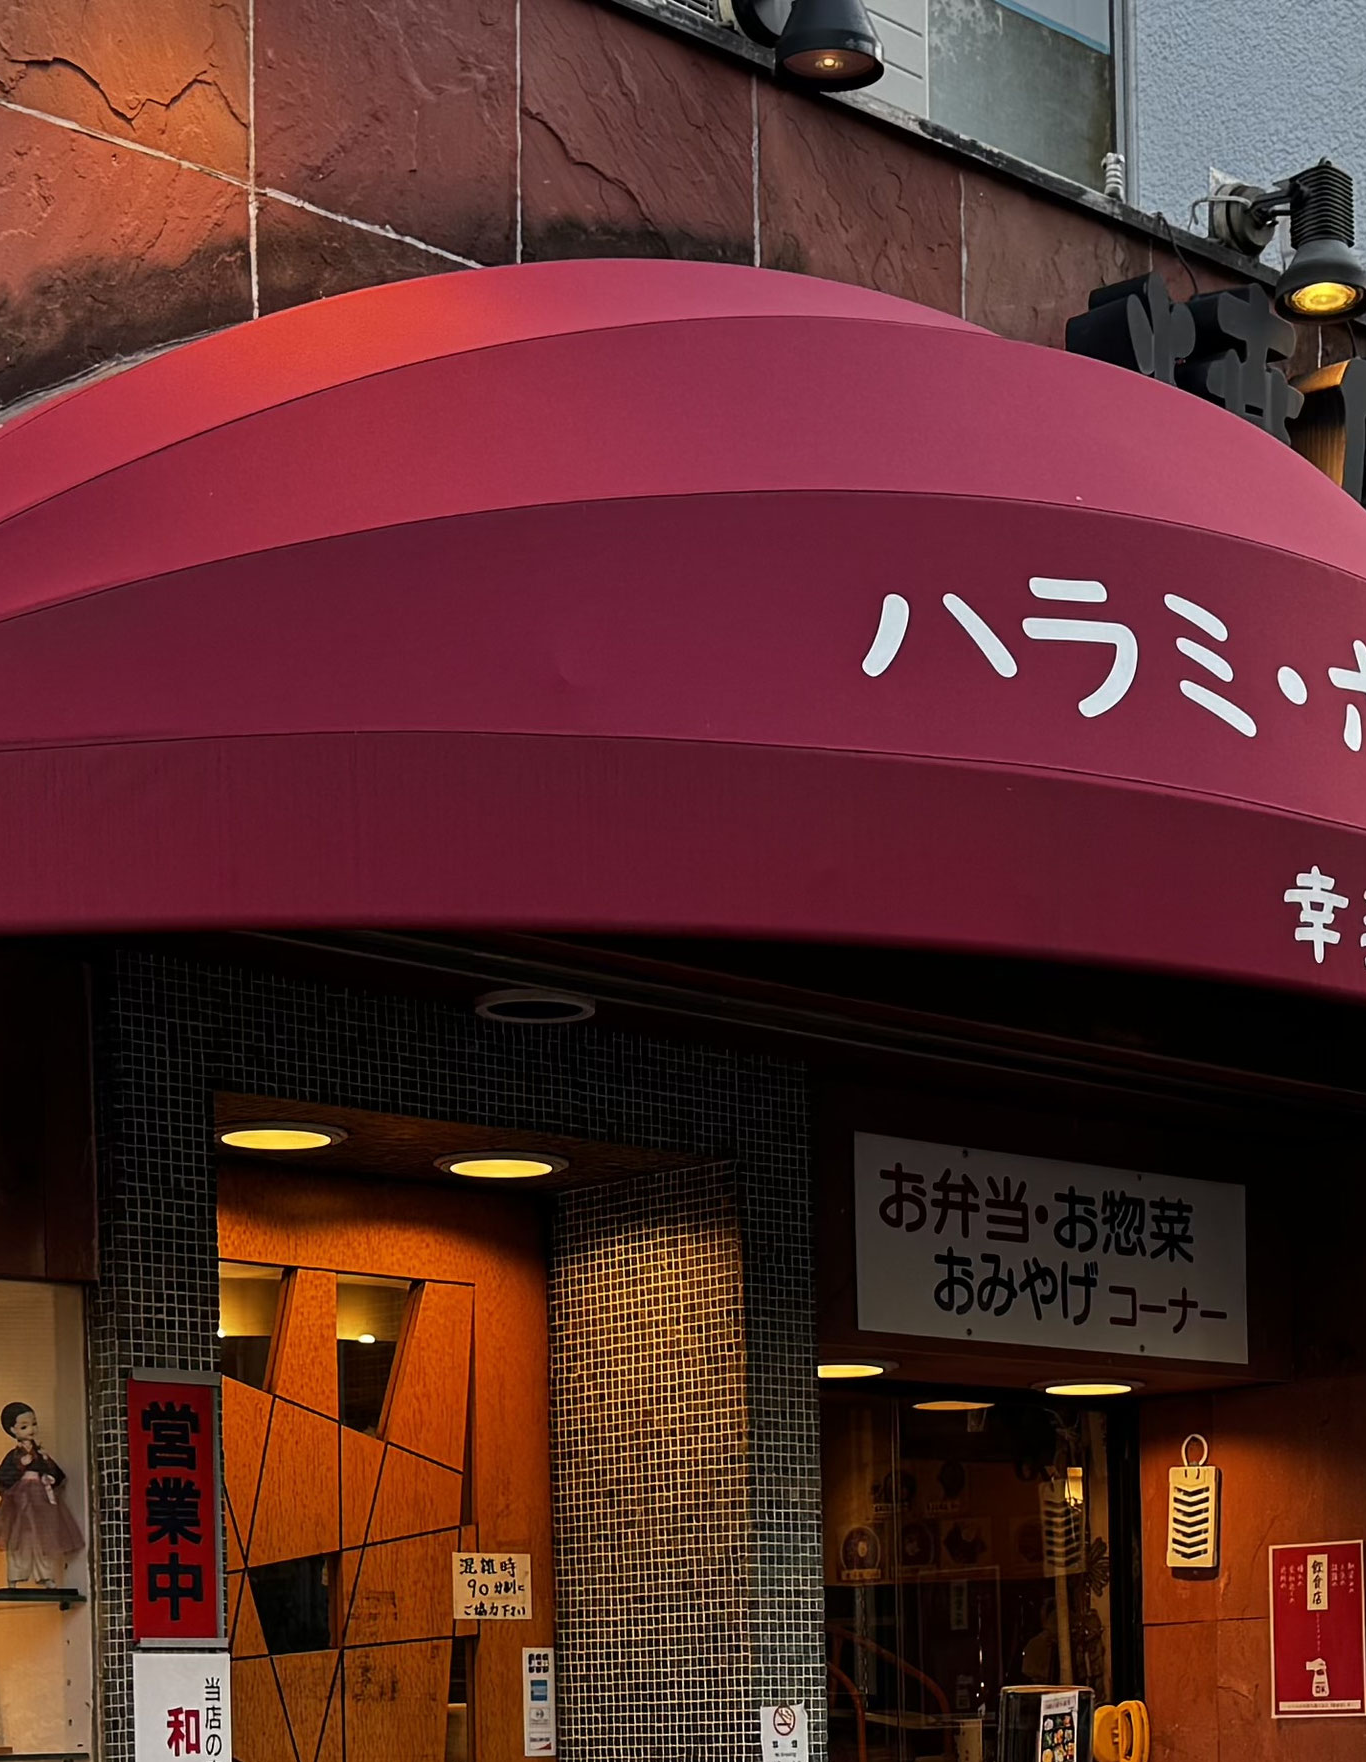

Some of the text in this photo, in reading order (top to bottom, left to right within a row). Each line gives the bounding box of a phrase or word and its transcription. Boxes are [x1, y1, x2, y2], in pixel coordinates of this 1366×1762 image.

[878, 1161, 1195, 1264] お弁当・お惣菜
[933, 1246, 1228, 1334] おみやげコーナー
[140, 1400, 205, 1622] 営業中
